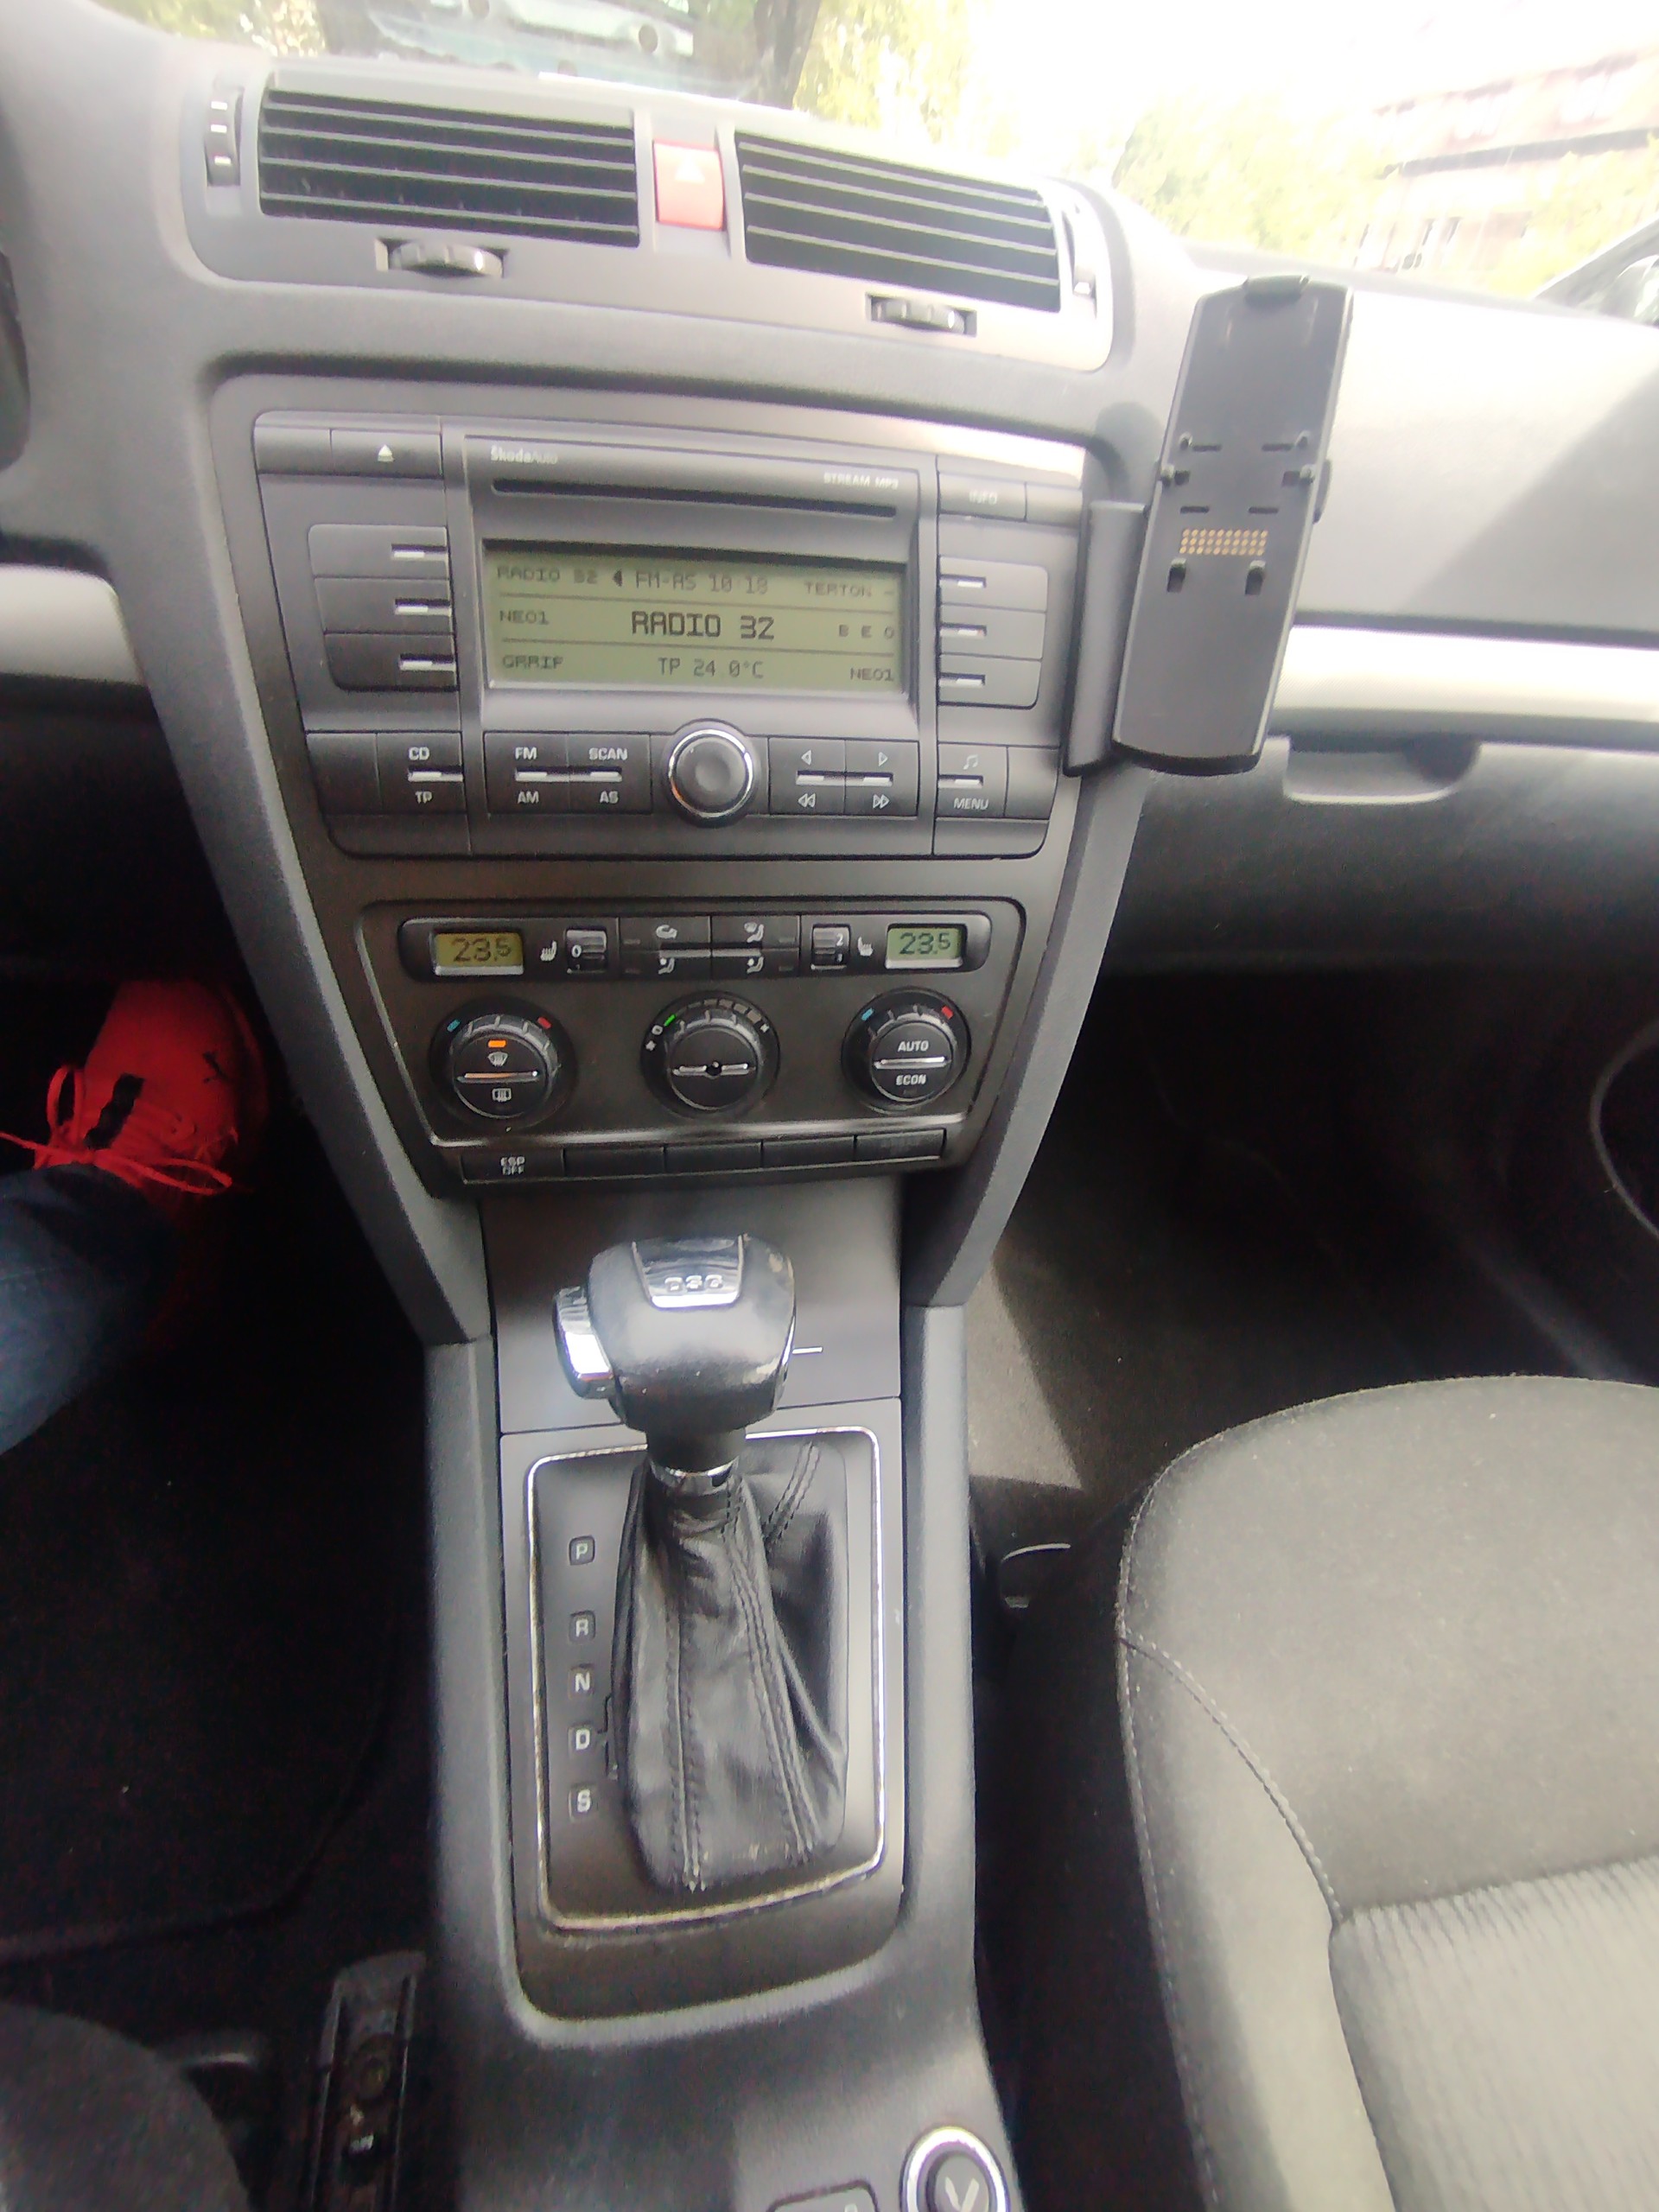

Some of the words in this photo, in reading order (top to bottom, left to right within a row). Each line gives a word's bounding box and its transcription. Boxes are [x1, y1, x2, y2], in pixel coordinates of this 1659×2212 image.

[497, 566, 560, 582] RADIO
[632, 611, 721, 638] RADIO
[741, 615, 774, 640] 32
[658, 658, 681, 676] TP
[408, 747, 430, 761] CD
[514, 747, 537, 760] FM
[588, 747, 628, 761] SCAN
[415, 791, 433, 804] TP
[518, 791, 540, 804] AM
[599, 791, 619, 804] AS
[953, 798, 990, 810] MENU
[897, 1039, 930, 1052] AUTO
[895, 1074, 927, 1086] ECON
[575, 1542, 588, 1560] P
[575, 1618, 589, 1637] R
[575, 1672, 591, 1693] N
[575, 1729, 591, 1751] D
[576, 1789, 592, 1813] S
